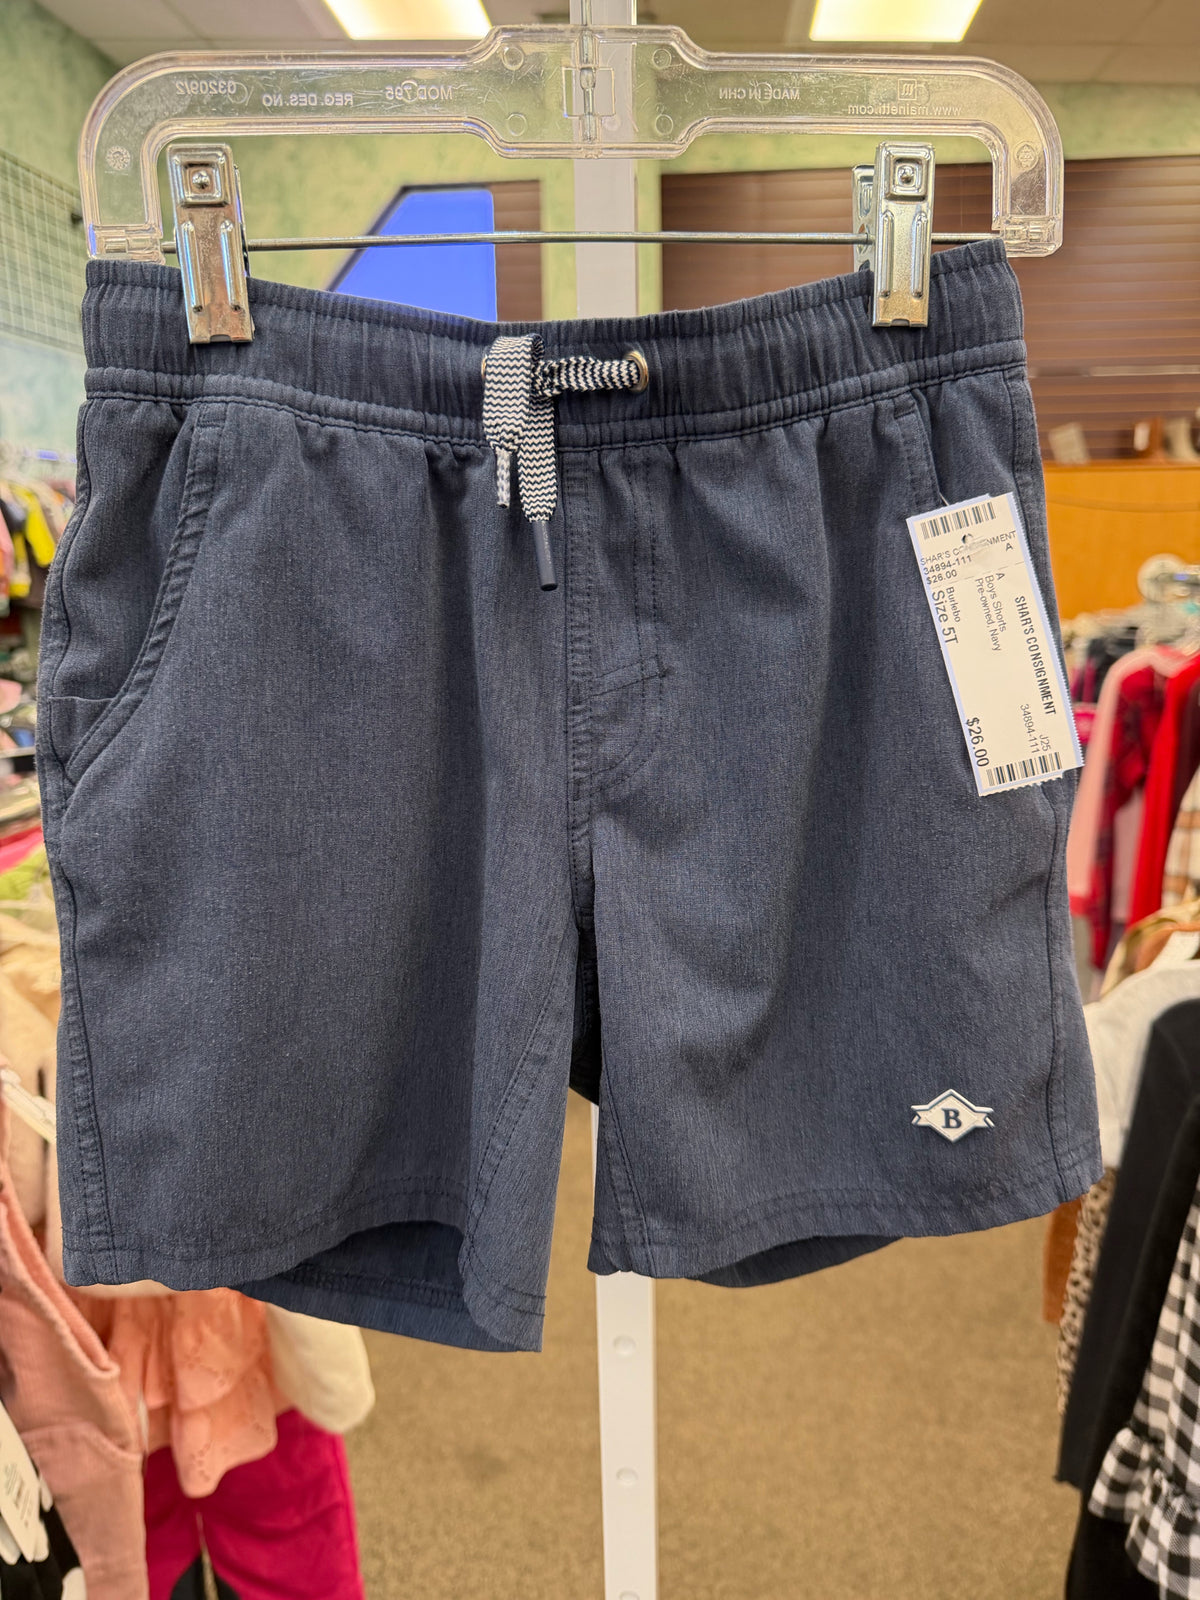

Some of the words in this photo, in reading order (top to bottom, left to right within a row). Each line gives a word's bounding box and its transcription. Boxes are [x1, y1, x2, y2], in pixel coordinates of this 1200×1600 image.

[920, 550, 951, 566] SHAR'S
[1005, 542, 1014, 552] A
[923, 555, 973, 575] 34894-111
[926, 569, 958, 585] $26.00
[995, 572, 1006, 581] A
[932, 590, 949, 623] Size
[941, 626, 959, 645] 5T
[946, 586, 961, 623] Burlebo
[975, 577, 995, 629] Pre-owned,
[988, 628, 1002, 652] Navy
[984, 574, 998, 600] Boys
[992, 600, 1008, 633] Shorts
[1014, 595, 1035, 636] SHAR'S
[1026, 636, 1057, 715] CONSIGNMENT
[965, 717, 990, 768] $26.00
[1020, 703, 1041, 754] 34894-111
[1039, 734, 1052, 752] J25
[941, 1107, 963, 1129] B
